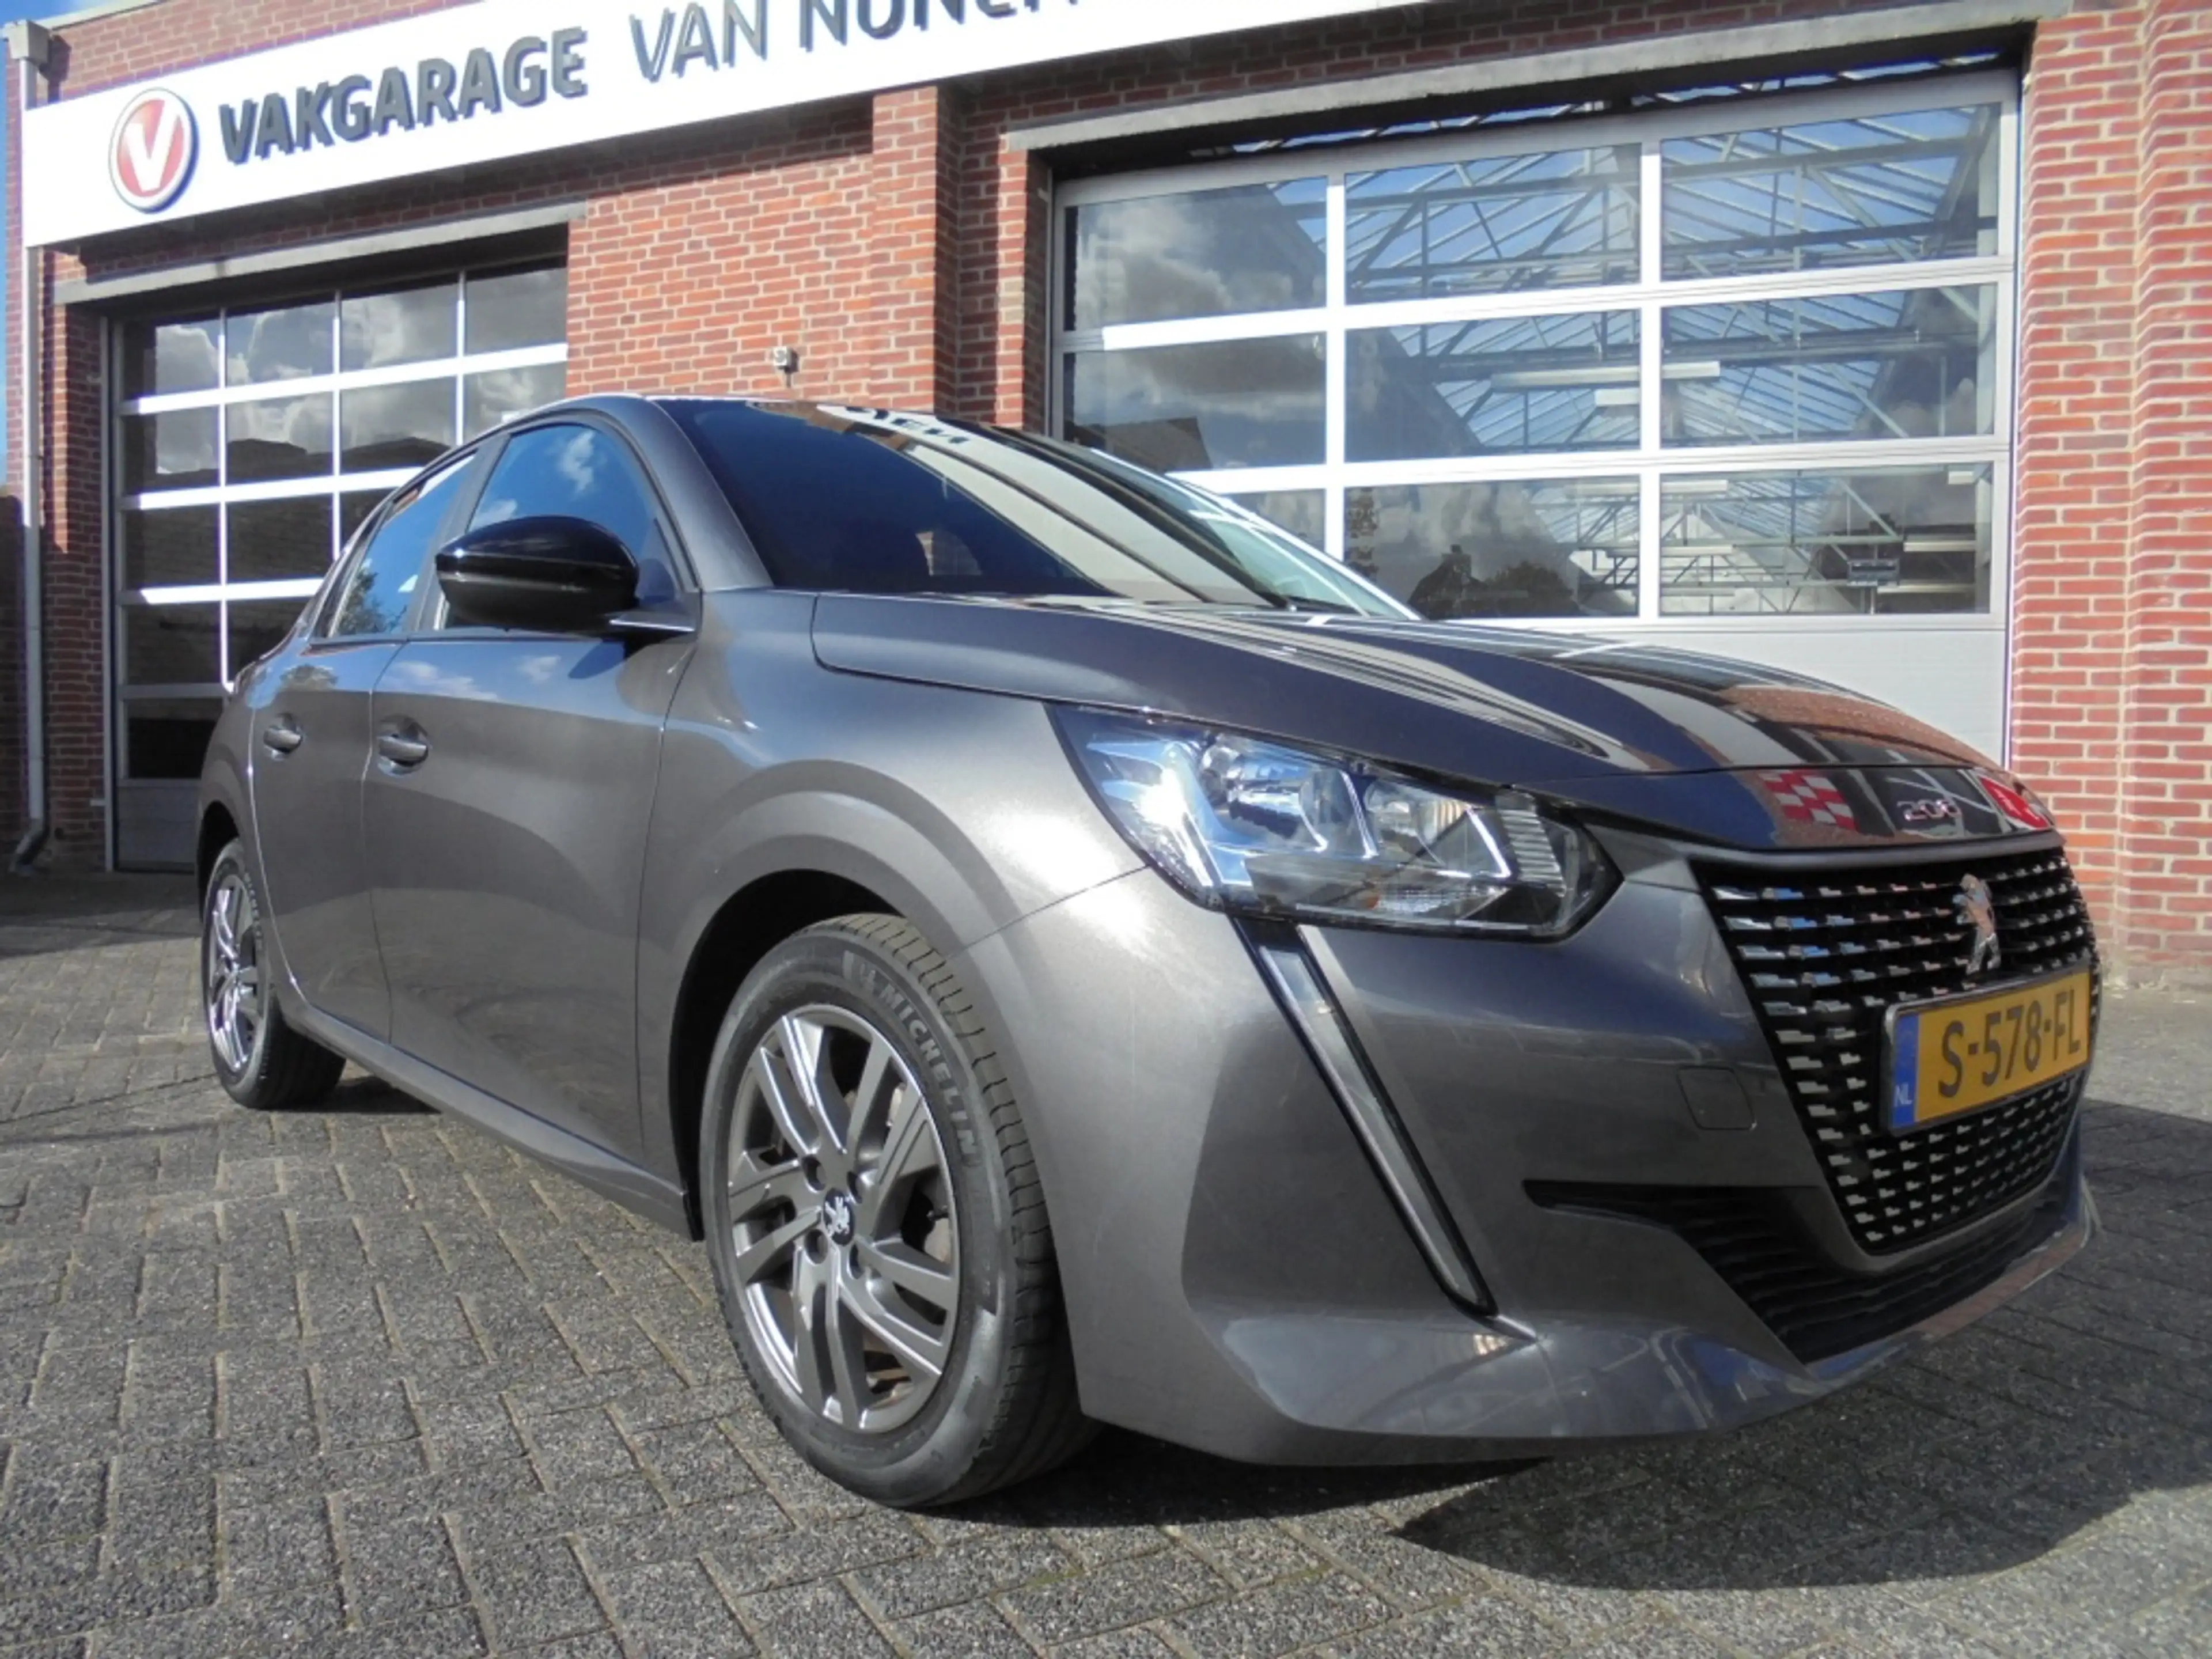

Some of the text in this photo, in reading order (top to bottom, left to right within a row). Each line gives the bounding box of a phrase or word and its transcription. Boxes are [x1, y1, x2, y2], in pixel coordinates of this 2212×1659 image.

[218, 26, 588, 165] VAKGARAGE
[628, 0, 767, 84] VAN
[118, 98, 187, 192] V
[880, 984, 979, 1153] MICHELIN
[1893, 1083, 1912, 1107] NL
[1938, 988, 2081, 1099] S-578-FL
